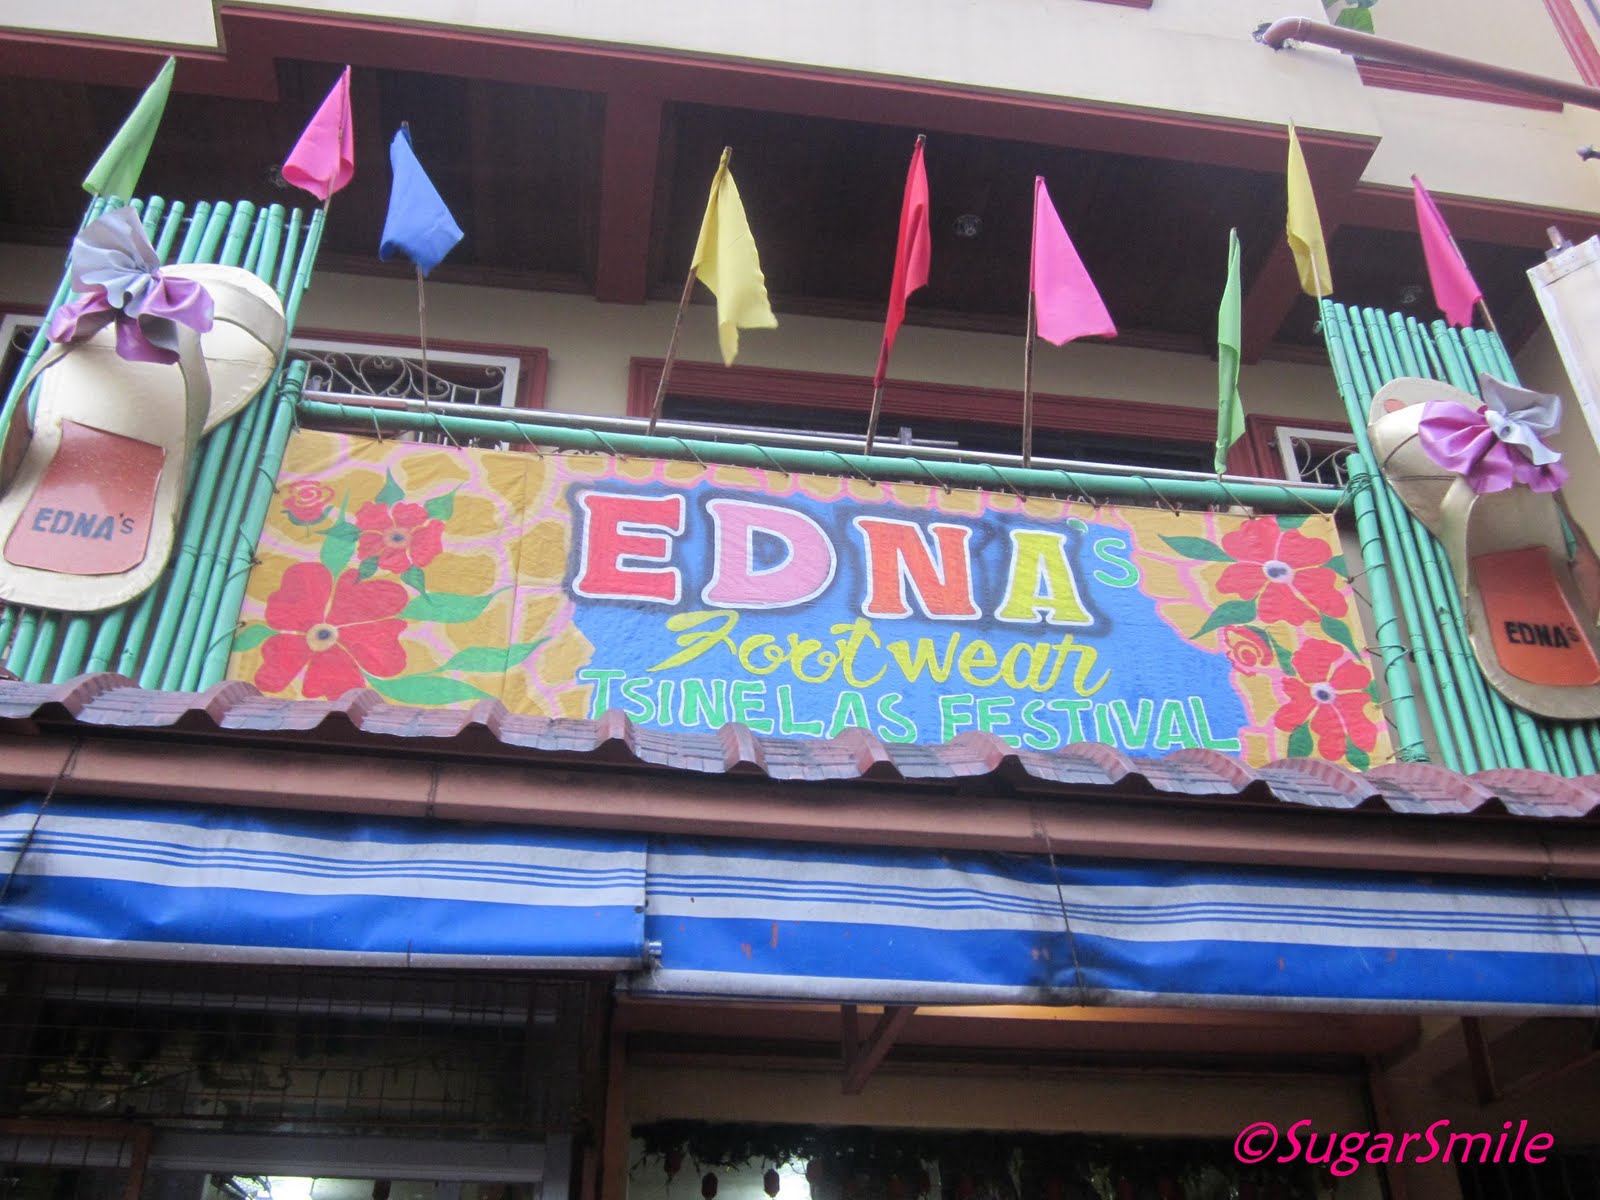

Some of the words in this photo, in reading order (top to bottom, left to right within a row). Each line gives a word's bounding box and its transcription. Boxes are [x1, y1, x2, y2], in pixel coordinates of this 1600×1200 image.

[32, 508, 135, 541] EDNA'S
[572, 490, 1139, 626] EDNA'S
[579, 669, 917, 743] TSINELAS
[939, 693, 1241, 751] FESTIVAL
